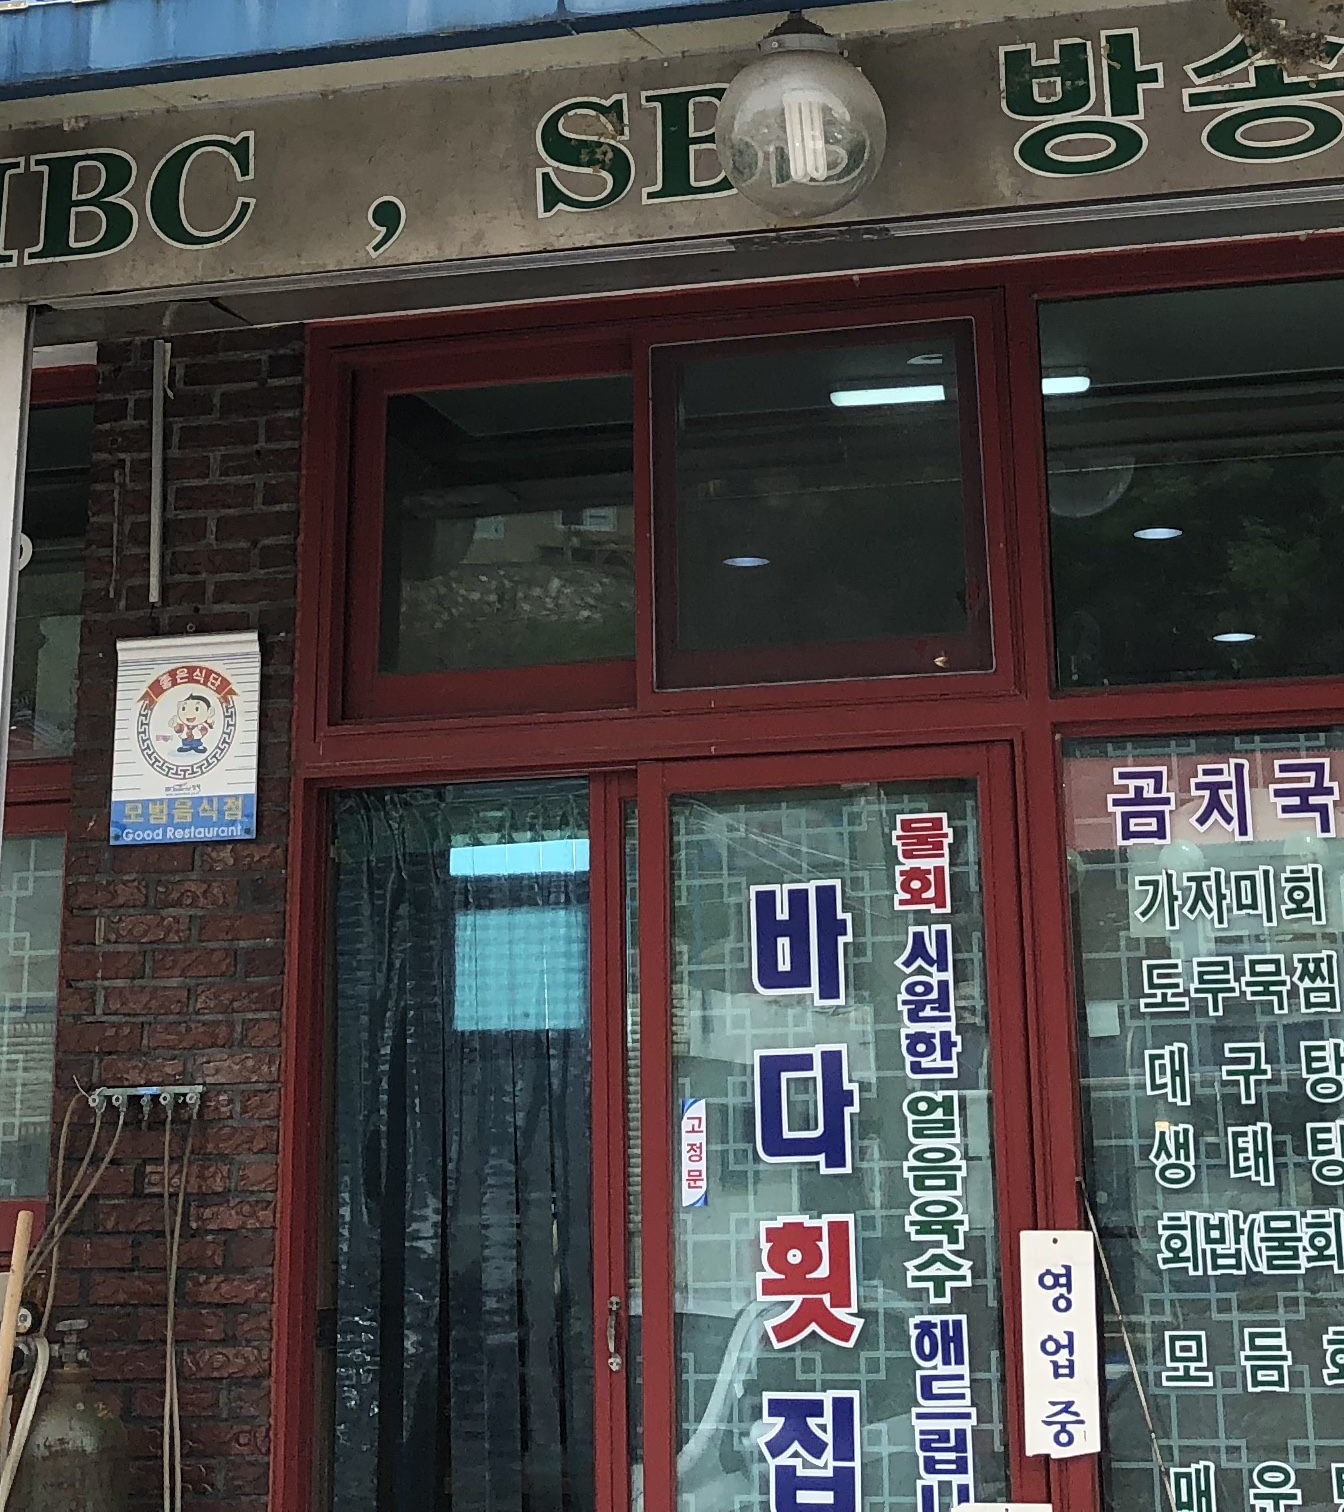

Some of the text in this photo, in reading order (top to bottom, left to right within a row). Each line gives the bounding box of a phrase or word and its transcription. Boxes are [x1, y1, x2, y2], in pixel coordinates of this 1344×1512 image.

[535, 67, 862, 220] SB
[159, 666, 222, 691] 좋은식단
[122, 795, 244, 824] 모범음식점
[122, 823, 242, 842] Good Restaurant
[1107, 756, 1340, 846] 곰치국
[892, 811, 954, 915] 물회
[1134, 863, 1328, 931] 가자미회
[895, 923, 959, 1080] 시원한
[1139, 948, 1342, 1017] 도루묵찜
[684, 1116, 705, 1190] 고정문
[1036, 1262, 1088, 1449] 영업중
